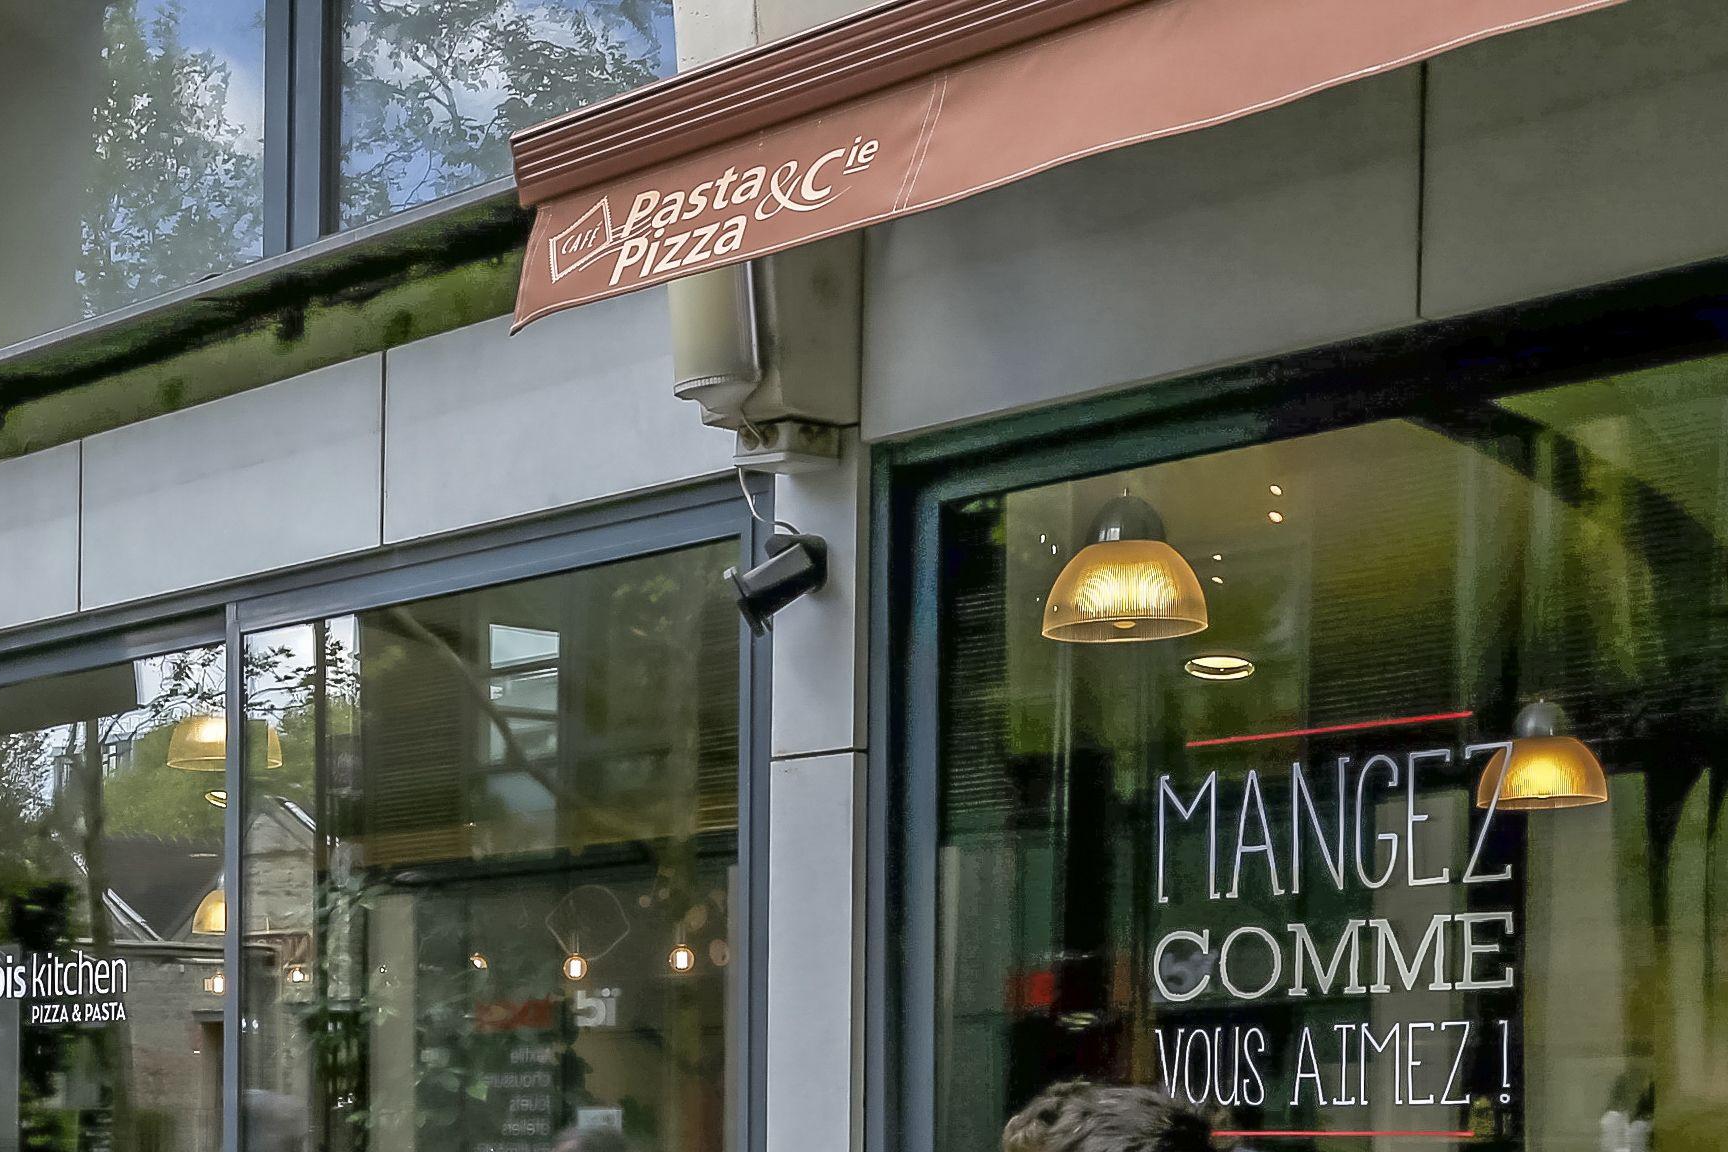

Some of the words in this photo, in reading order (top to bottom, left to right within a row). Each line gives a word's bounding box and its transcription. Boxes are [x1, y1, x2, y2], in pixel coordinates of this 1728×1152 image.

[561, 221, 603, 256] CAFÉ
[608, 214, 747, 287] Pizza
[1156, 741, 1515, 904] MANGEZ
[31, 950, 128, 997] kitchen
[1153, 910, 1515, 1003] COMME
[31, 1005, 70, 1023] PIZZA
[72, 1004, 82, 1022] &
[84, 1003, 126, 1022] PASTA
[1155, 1027, 1265, 1107] VOUS
[1290, 1021, 1471, 1107] AIMEZ
